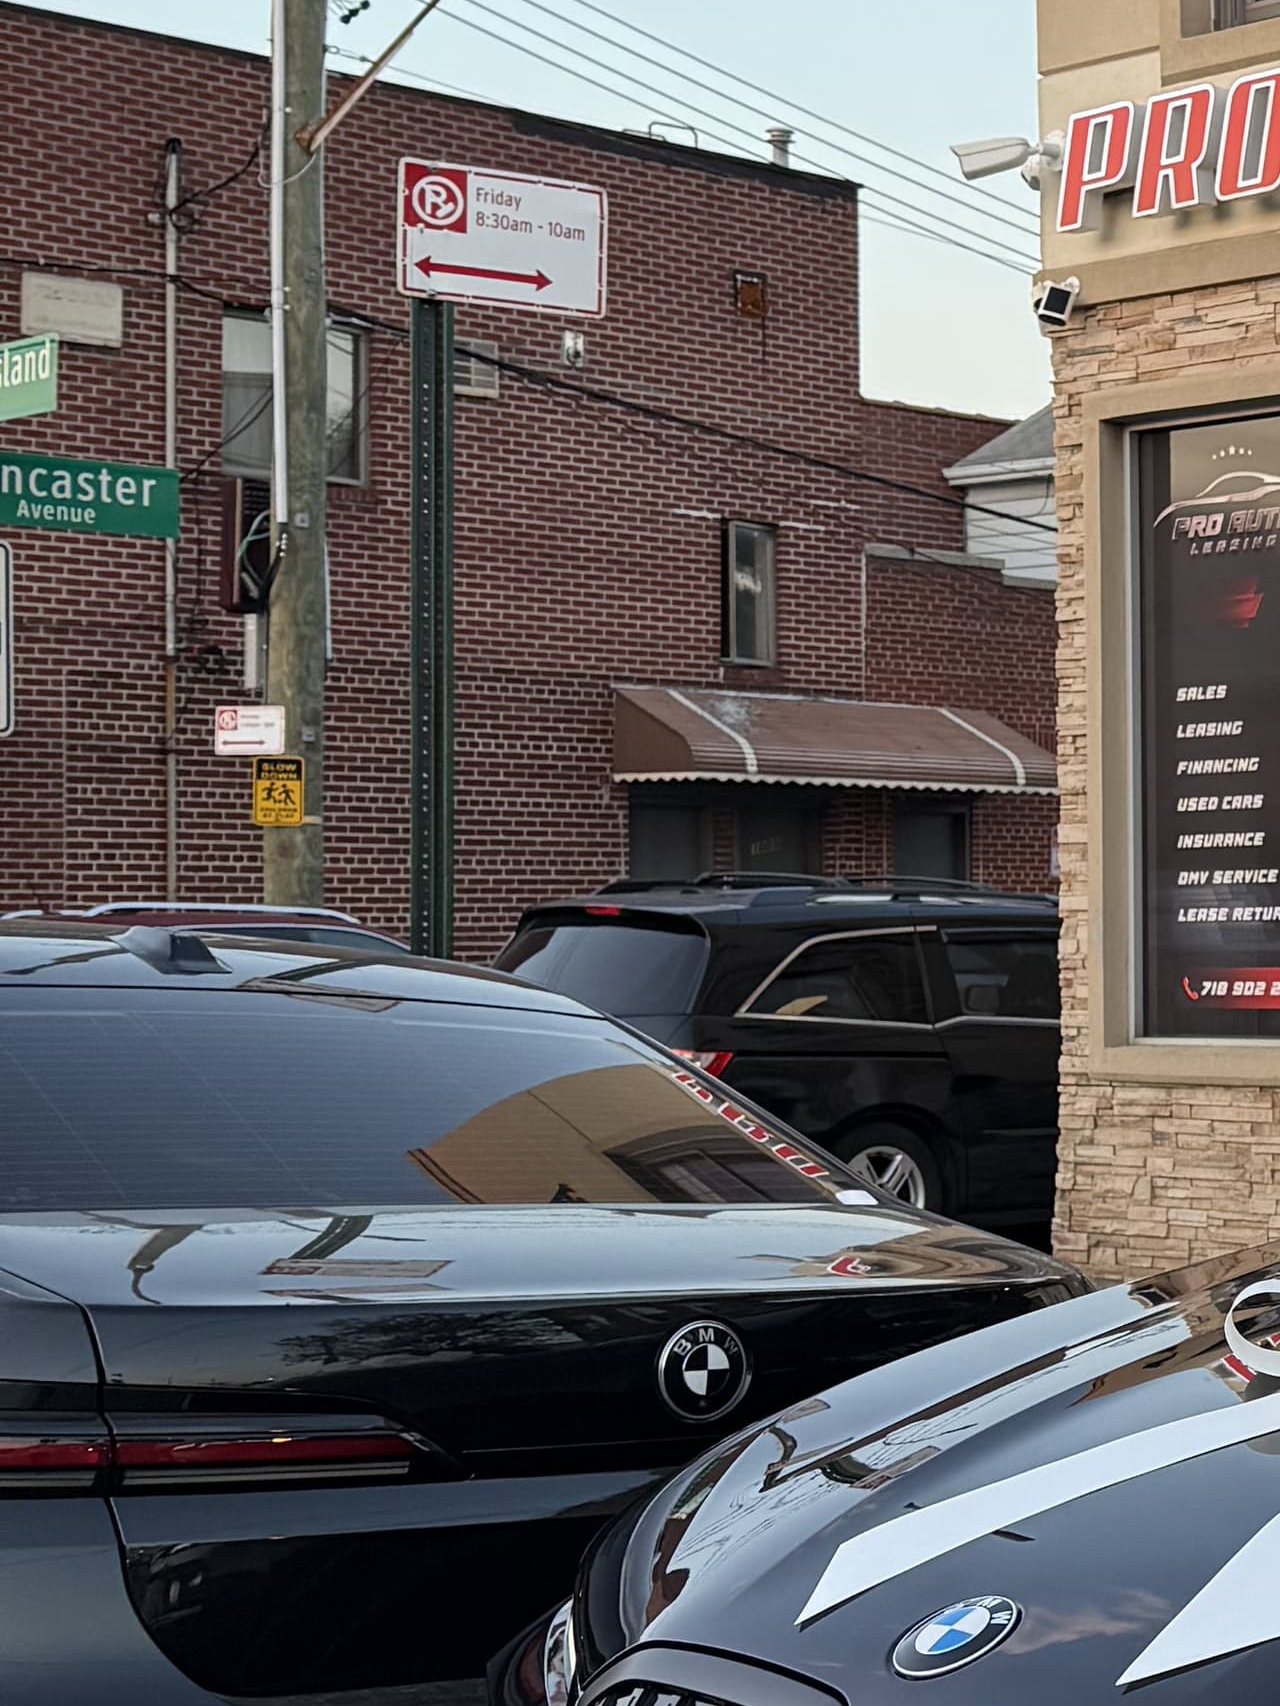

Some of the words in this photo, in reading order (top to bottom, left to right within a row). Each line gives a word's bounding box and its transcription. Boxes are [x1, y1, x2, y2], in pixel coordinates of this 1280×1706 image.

[476, 187, 522, 212] Friday
[475, 211, 532, 234] 8:30am
[550, 222, 585, 241] 10am
[0, 338, 50, 388] land
[1, 463, 156, 507] ncaster
[16, 499, 96, 524] Avenue
[1172, 512, 1224, 540] PRO
[1190, 534, 1277, 555] LEASING
[1176, 685, 1227, 701] SALES
[1176, 721, 1243, 738] LEASING
[1177, 757, 1260, 775] FINANCING
[1177, 796, 1219, 812] USED
[1221, 794, 1264, 810] CARS
[1177, 832, 1265, 849] INSURANCE
[1177, 870, 1209, 886] DMV
[1212, 869, 1279, 885] SERVICE
[1177, 906, 1229, 922] LEASE
[1200, 981, 1228, 996] 718
[1232, 981, 1266, 996] 902
[673, 1327, 738, 1356] BMW
